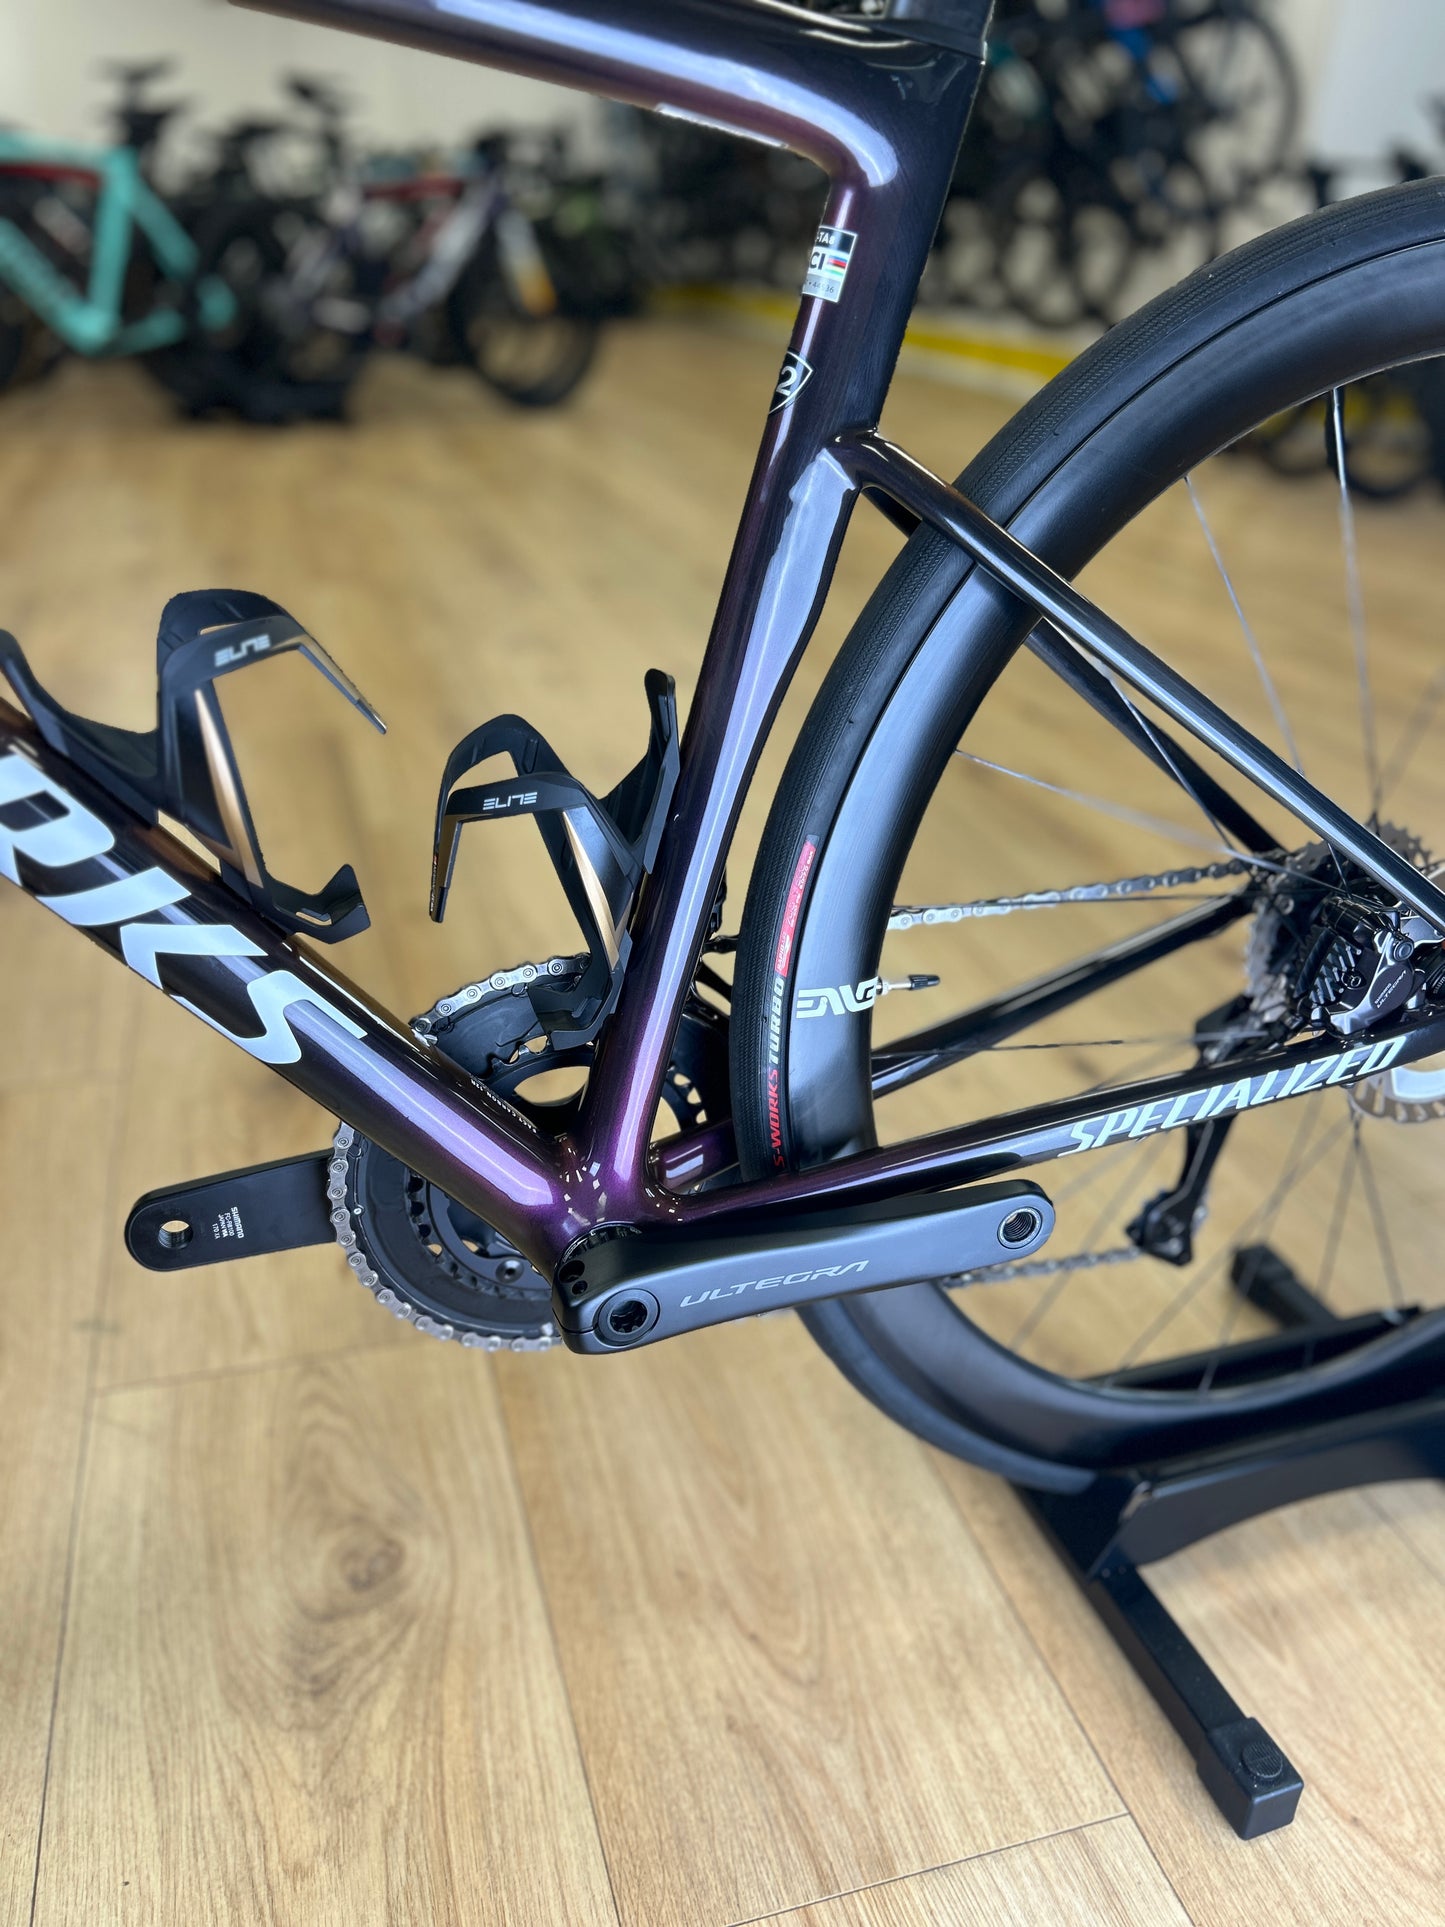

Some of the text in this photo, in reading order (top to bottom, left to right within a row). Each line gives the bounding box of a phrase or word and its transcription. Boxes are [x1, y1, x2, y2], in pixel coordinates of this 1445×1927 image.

[776, 365, 797, 396] 2
[482, 791, 538, 811] ELITE
[1377, 969, 1406, 1009] ULTEGRA
[769, 977, 786, 1065] TURBO
[768, 1067, 786, 1169] S-WORKS
[1058, 1036, 1407, 1158] SPECIALIZED
[231, 1206, 244, 1238] SHIMANO
[680, 1259, 869, 1308] ULTEGRA
